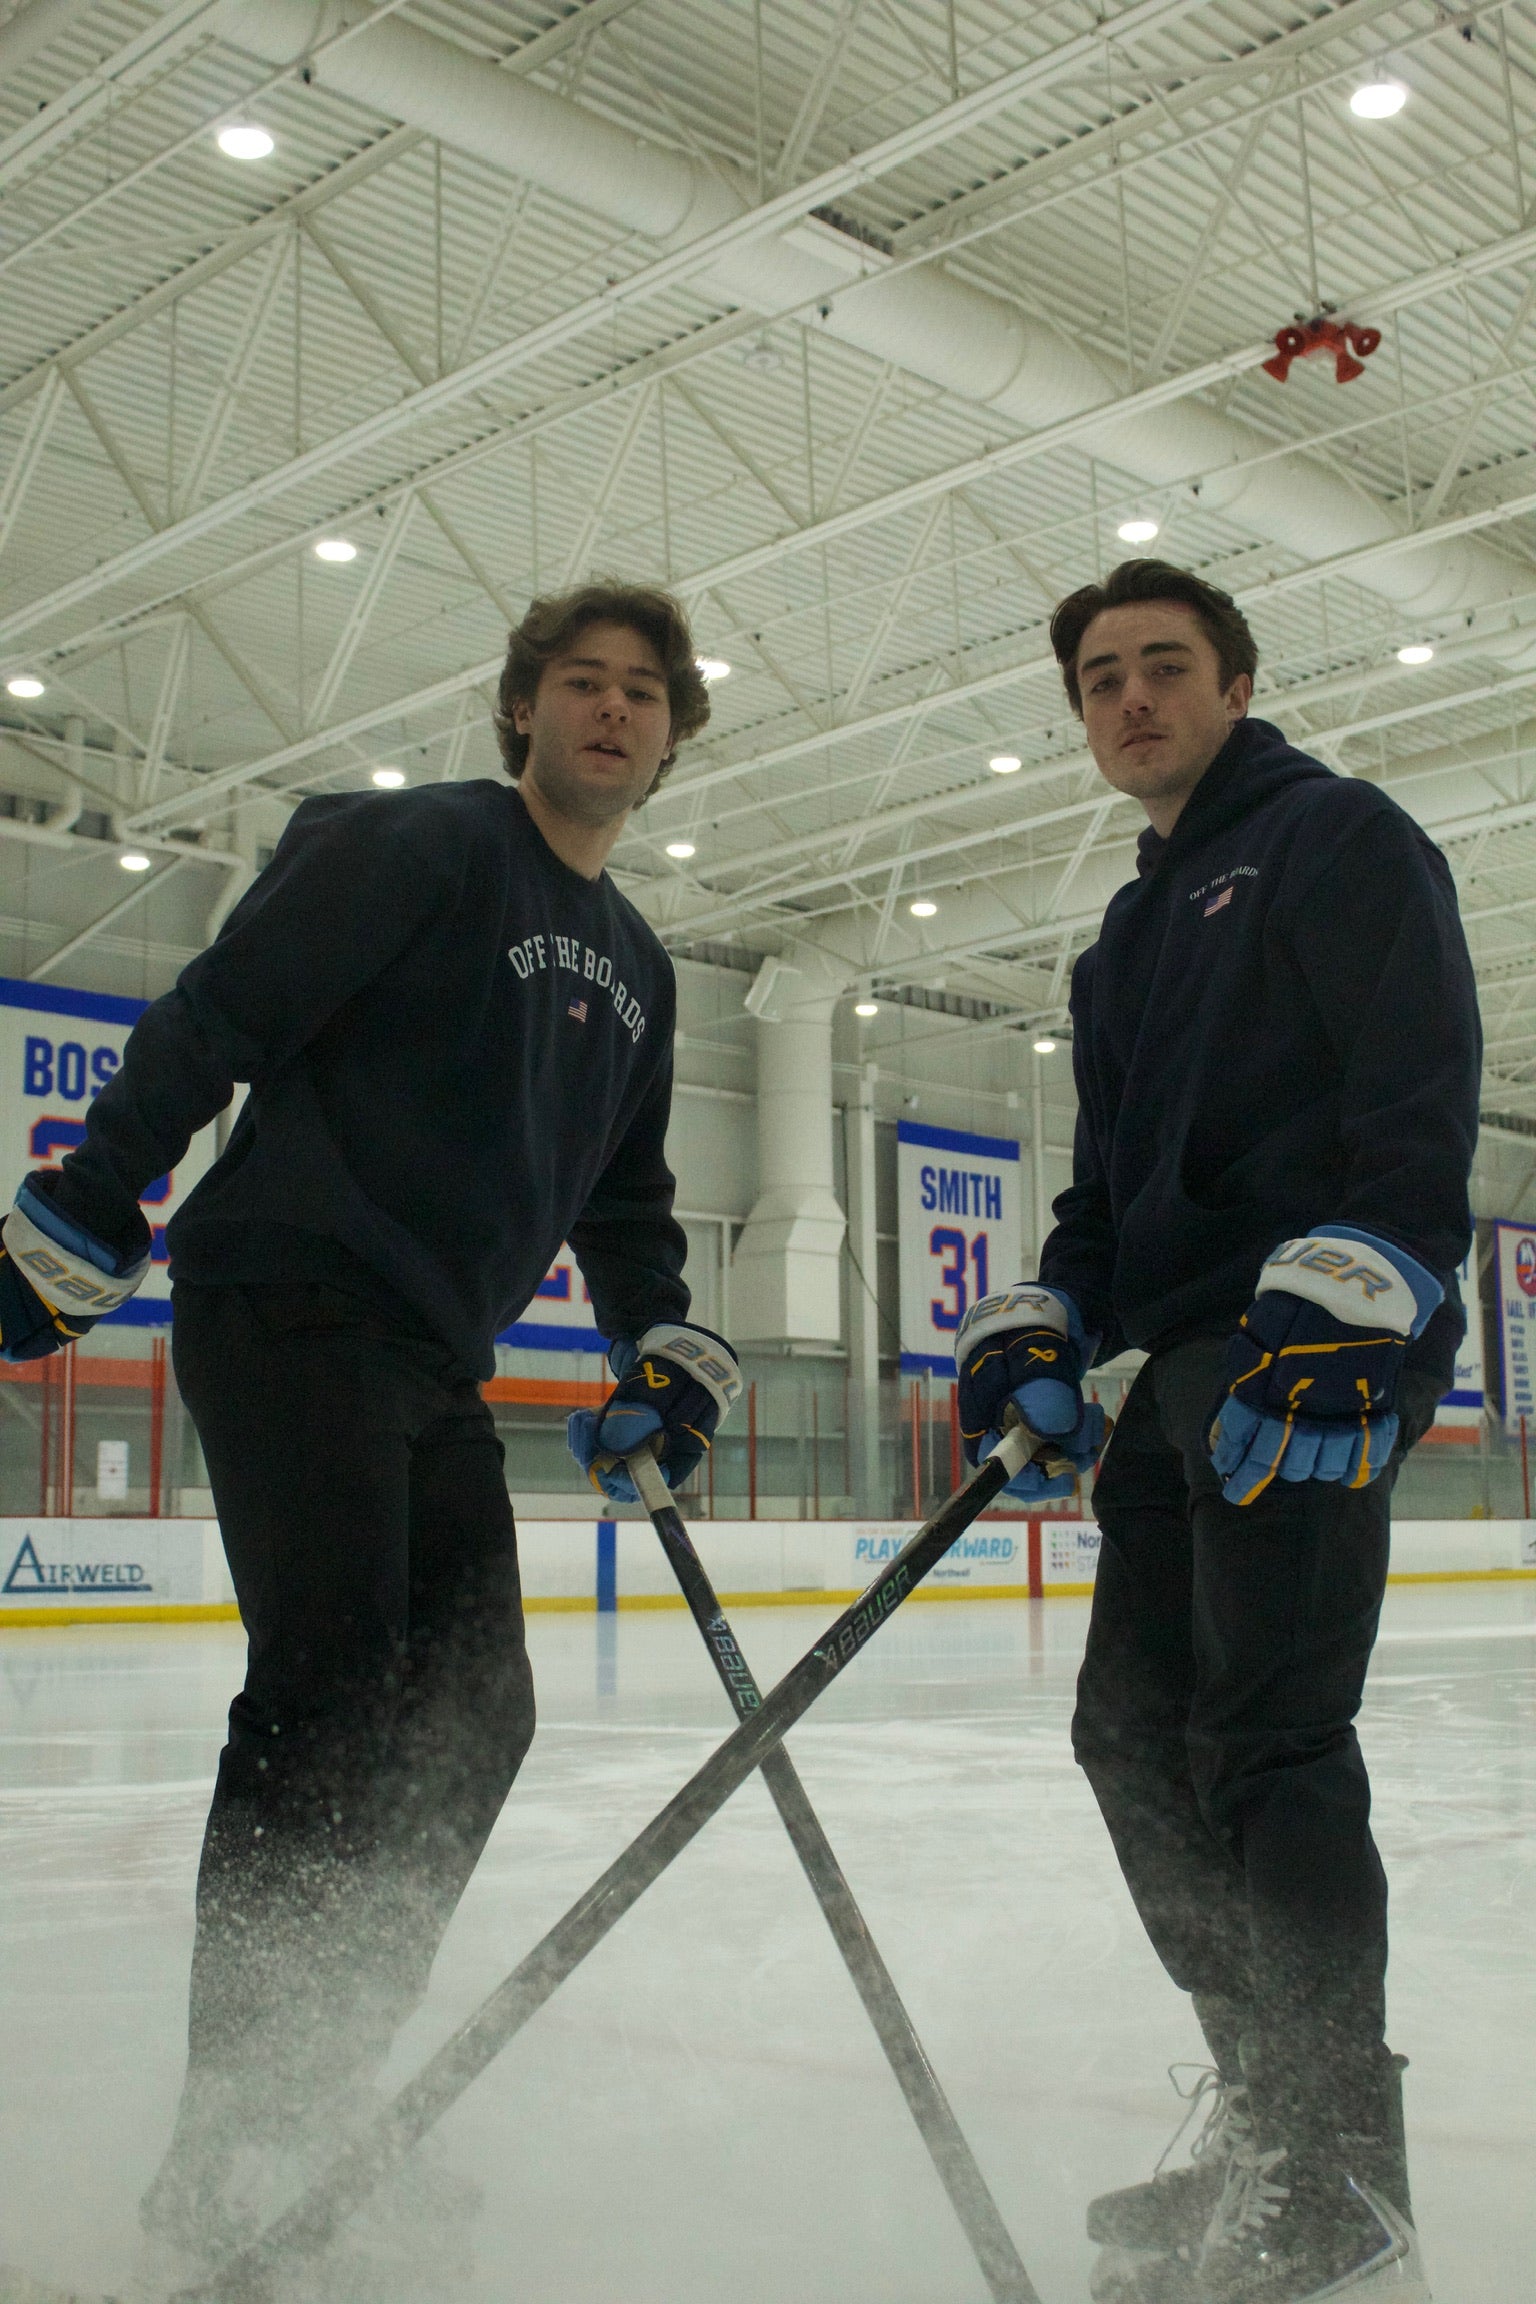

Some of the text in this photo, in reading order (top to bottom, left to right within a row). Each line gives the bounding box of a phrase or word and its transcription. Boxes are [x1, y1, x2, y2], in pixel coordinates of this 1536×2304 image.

[508, 933, 646, 1044] OFF HE BORDS
[920, 1164, 1003, 1221] SMITH
[929, 1225, 989, 1333] 31
[2, 1533, 145, 1592] AIRWELD
[855, 1537, 903, 1560] PLAY
